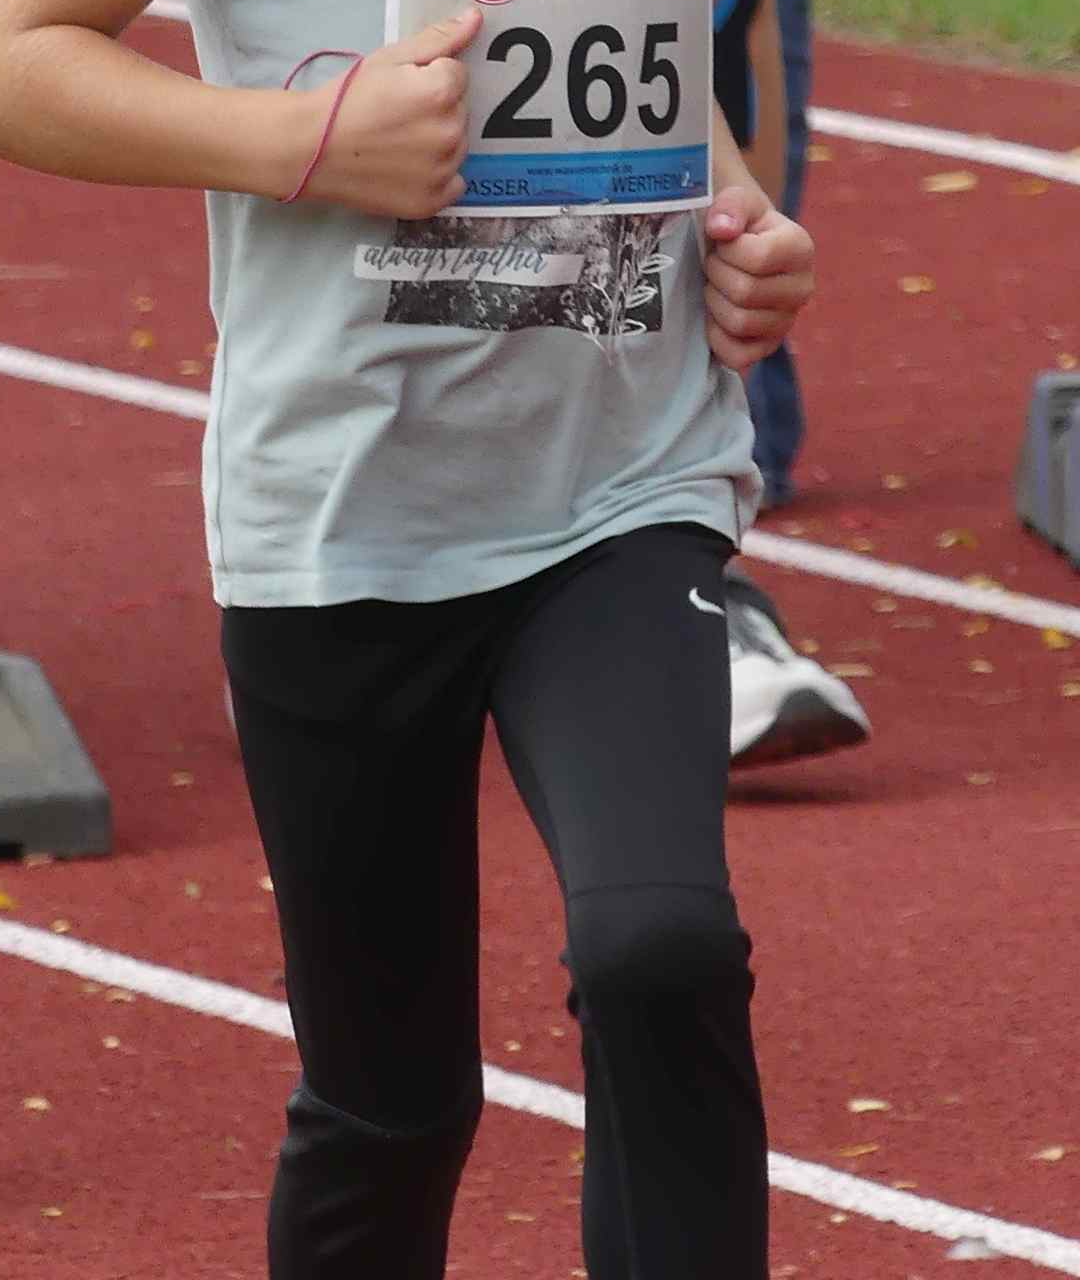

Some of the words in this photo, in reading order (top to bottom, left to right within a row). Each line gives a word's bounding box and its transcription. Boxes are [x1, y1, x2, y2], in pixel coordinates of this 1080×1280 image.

[480, 21, 681, 140] 265
[465, 177, 531, 198] ASSER
[363, 243, 448, 281] always
